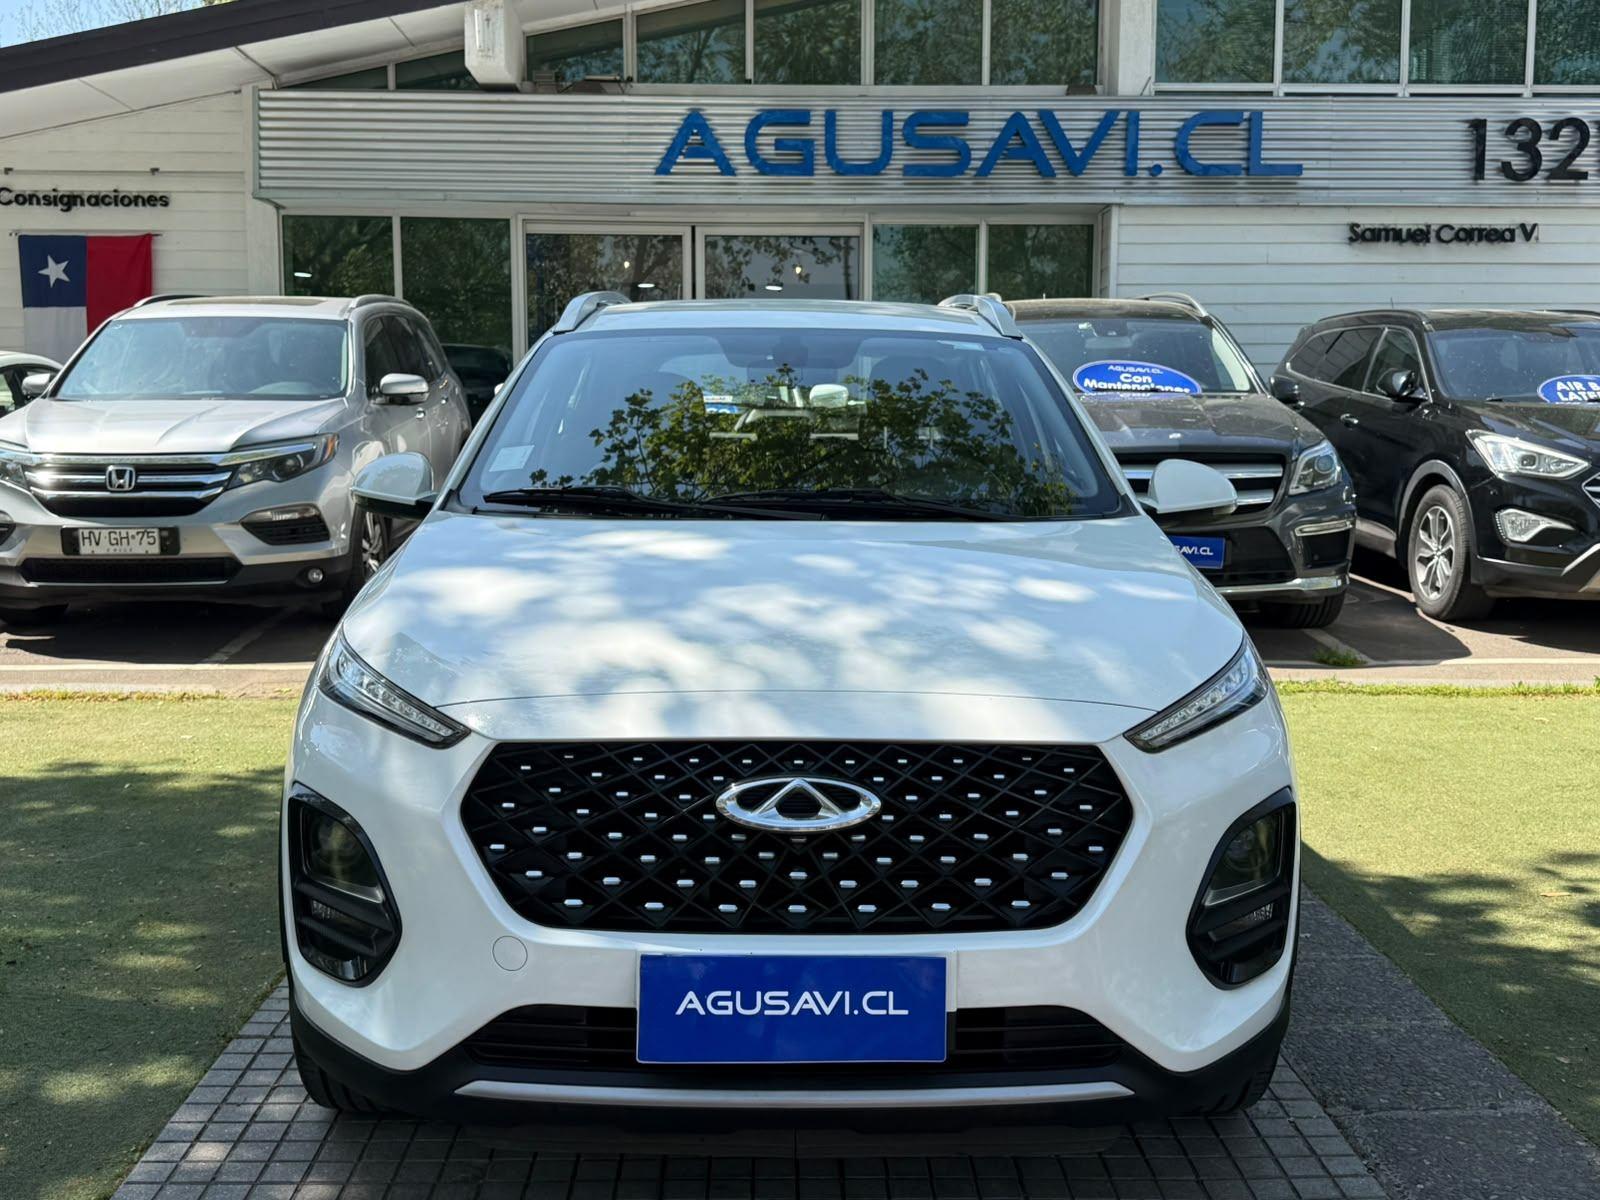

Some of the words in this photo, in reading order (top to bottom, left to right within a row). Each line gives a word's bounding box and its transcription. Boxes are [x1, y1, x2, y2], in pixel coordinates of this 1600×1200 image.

[654, 109, 1303, 178] AGUSAVI.CL
[1467, 117, 1600, 182] 132
[0, 187, 169, 212] Consignaciones
[1349, 223, 1432, 243] Samuel
[1435, 224, 1516, 243] Correa
[1120, 373, 1152, 383] Con
[1557, 381, 1586, 391] AIR
[675, 990, 909, 1016] AGUSAVI.CL
